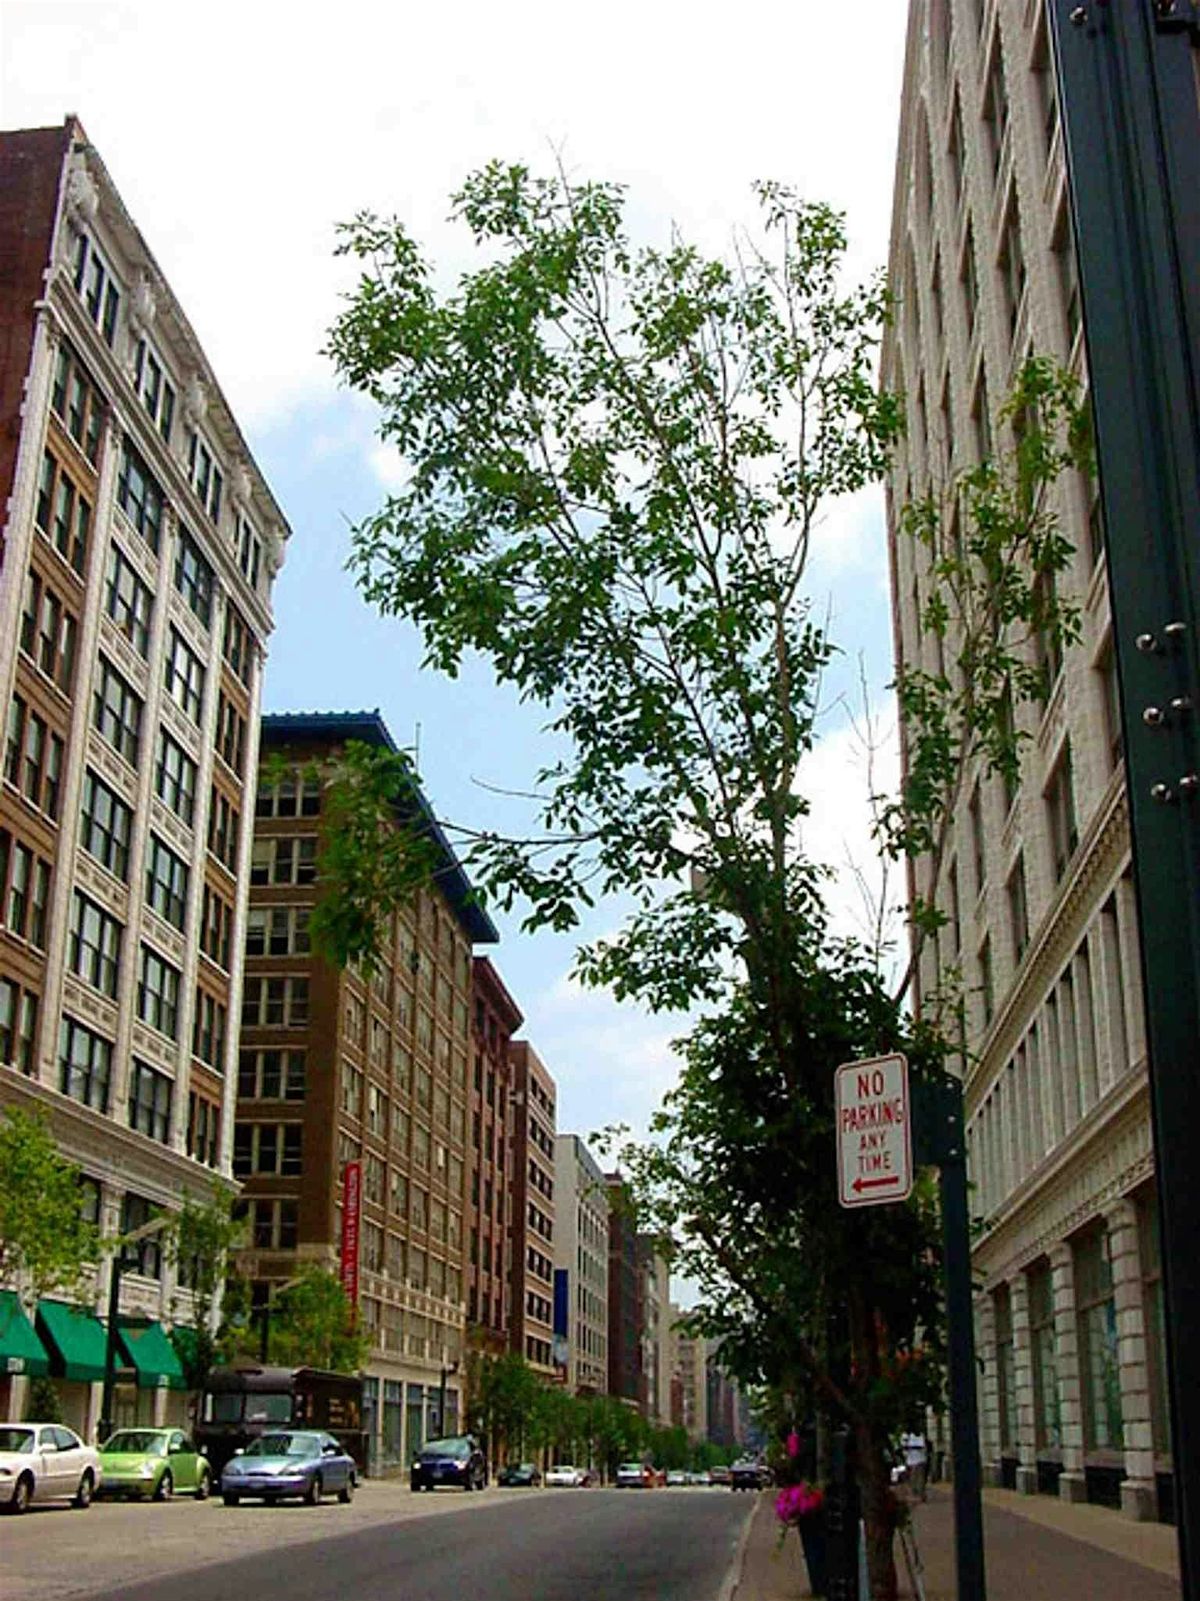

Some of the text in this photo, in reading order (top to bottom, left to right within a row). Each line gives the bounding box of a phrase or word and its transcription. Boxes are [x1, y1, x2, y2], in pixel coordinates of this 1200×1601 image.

[857, 1070, 884, 1098] NO
[842, 1098, 902, 1134] PARKING
[859, 1130, 886, 1151] ANY
[857, 1151, 892, 1174] TIME
